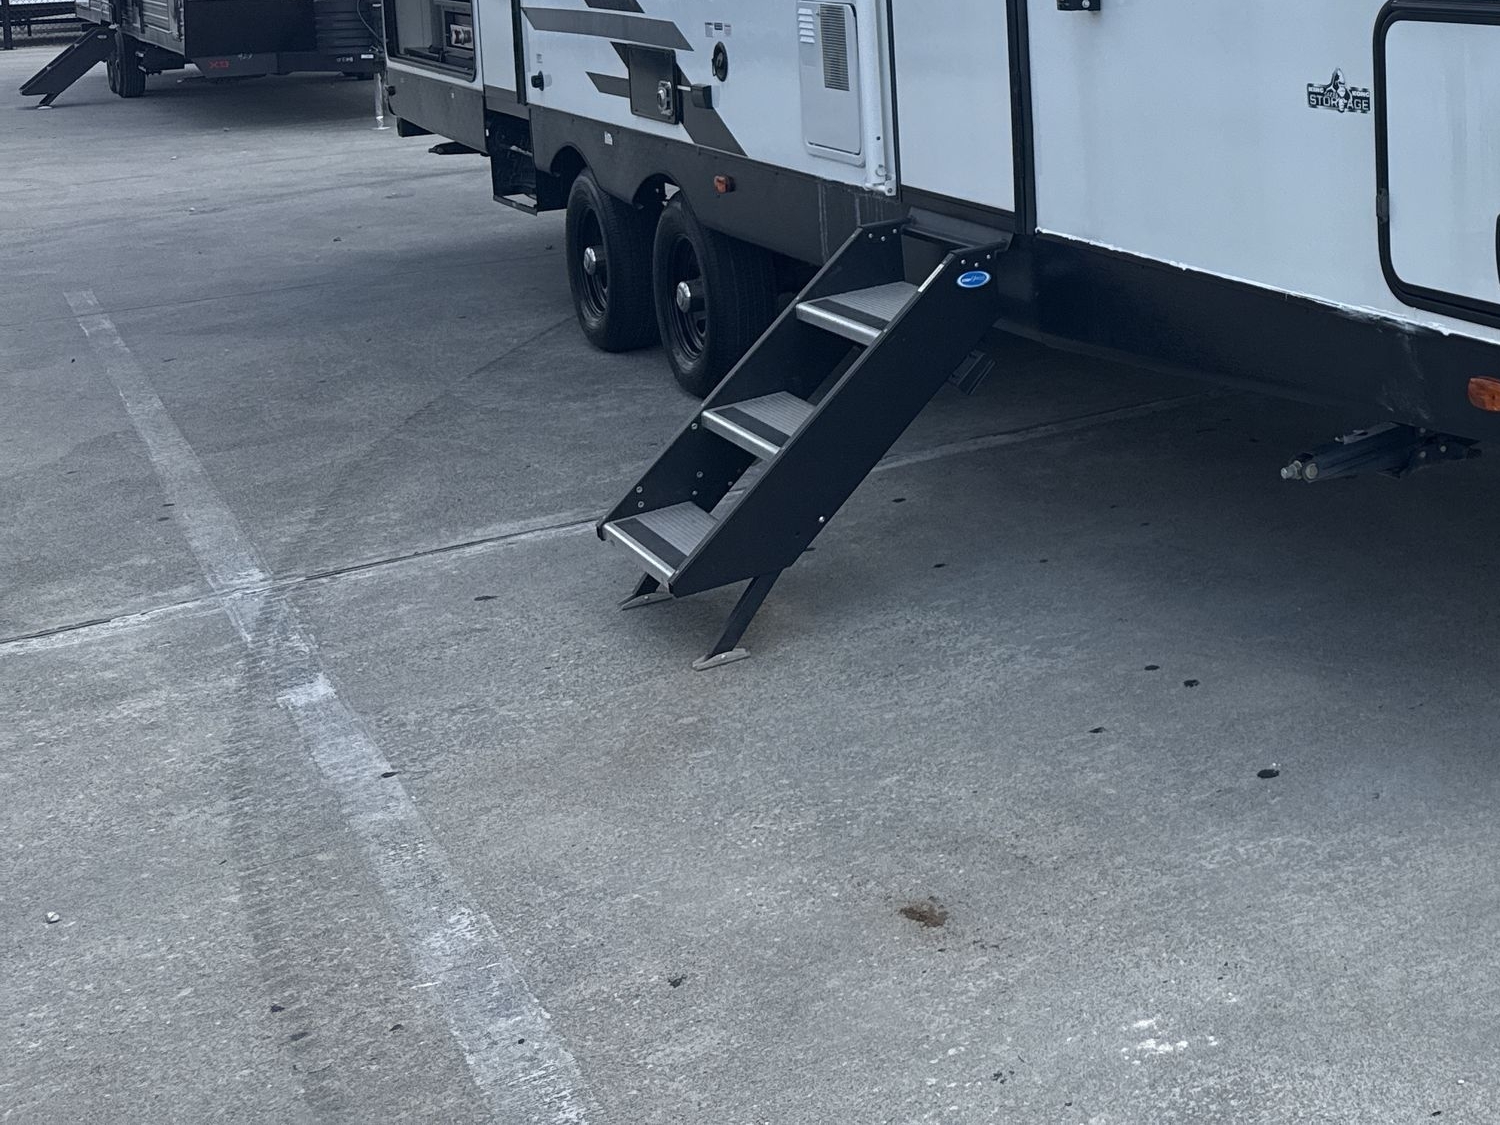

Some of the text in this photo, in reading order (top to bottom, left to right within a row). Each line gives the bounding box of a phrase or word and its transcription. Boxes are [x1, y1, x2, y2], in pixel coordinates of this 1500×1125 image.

[1308, 86, 1370, 98] KING KONG
[1309, 93, 1369, 110] STORAGE
